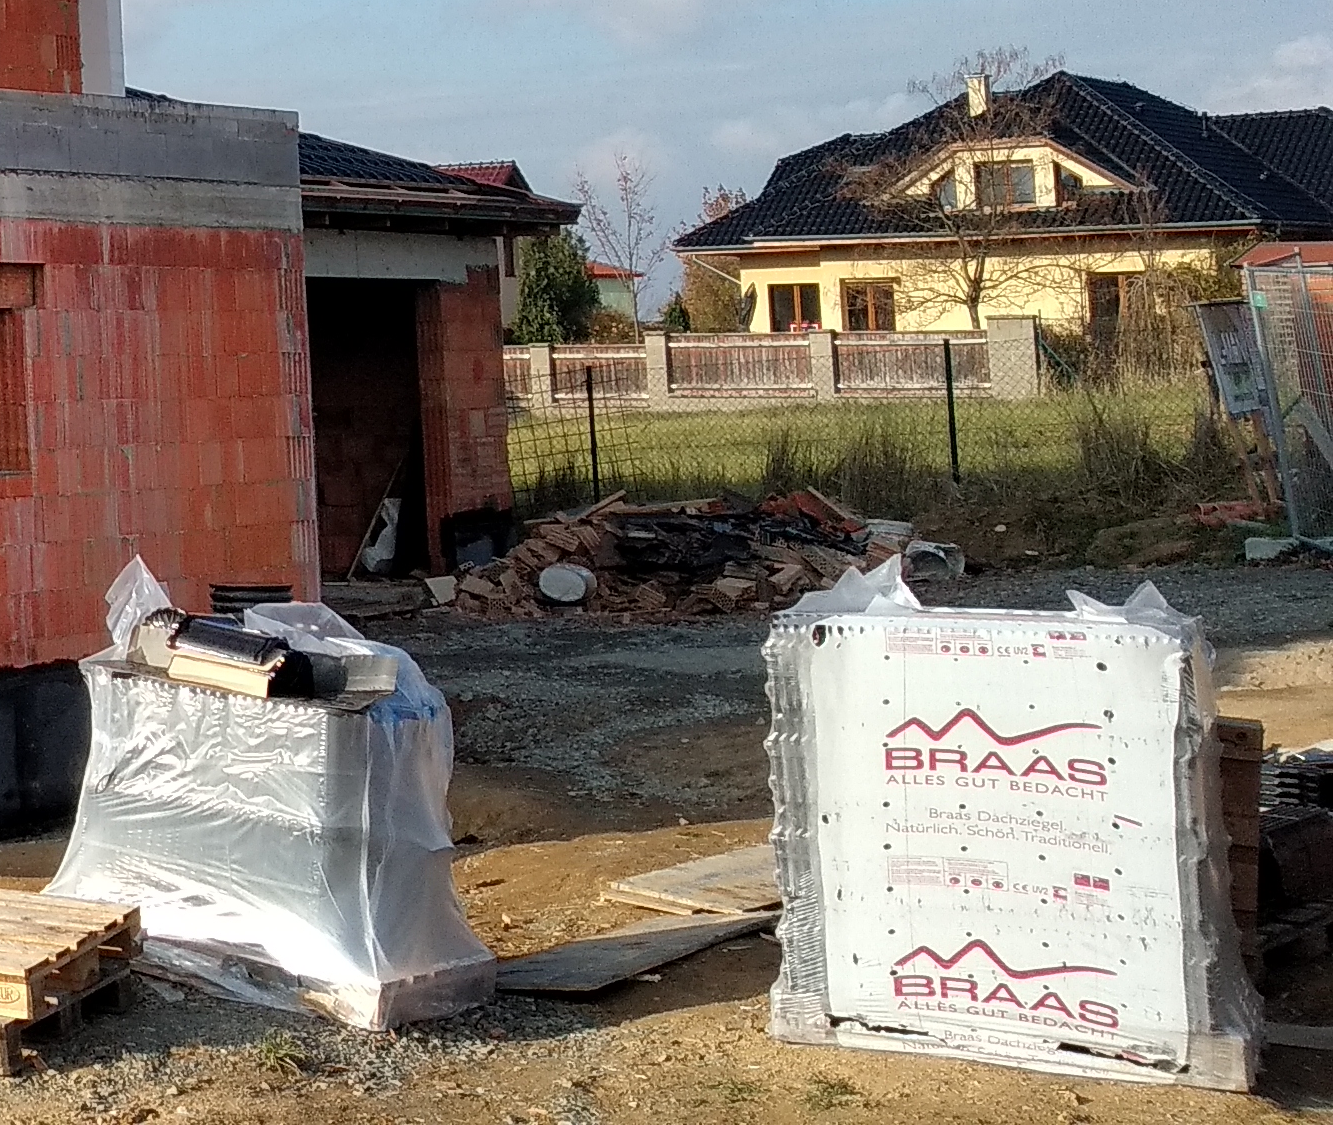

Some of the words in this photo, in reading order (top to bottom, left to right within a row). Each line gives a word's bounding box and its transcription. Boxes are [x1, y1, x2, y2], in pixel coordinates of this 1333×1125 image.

[885, 747, 1108, 786] BRAAS
[886, 774, 946, 786] ALLES
[955, 776, 1000, 790] GUT
[1009, 780, 1109, 803] BEDACHT
[929, 808, 971, 821] Braas
[977, 810, 1068, 832] Dachziegel.
[885, 822, 963, 836] Natürlich.
[967, 825, 1020, 841] Schön.
[1020, 830, 1113, 855] Traditionell.
[893, 975, 1120, 1029] BRAAS
[897, 1000, 958, 1013] ALLES
[966, 1006, 1009, 1019] GUT
[1018, 1013, 1118, 1041] BEDACHT
[944, 1030, 982, 1043] Braas
